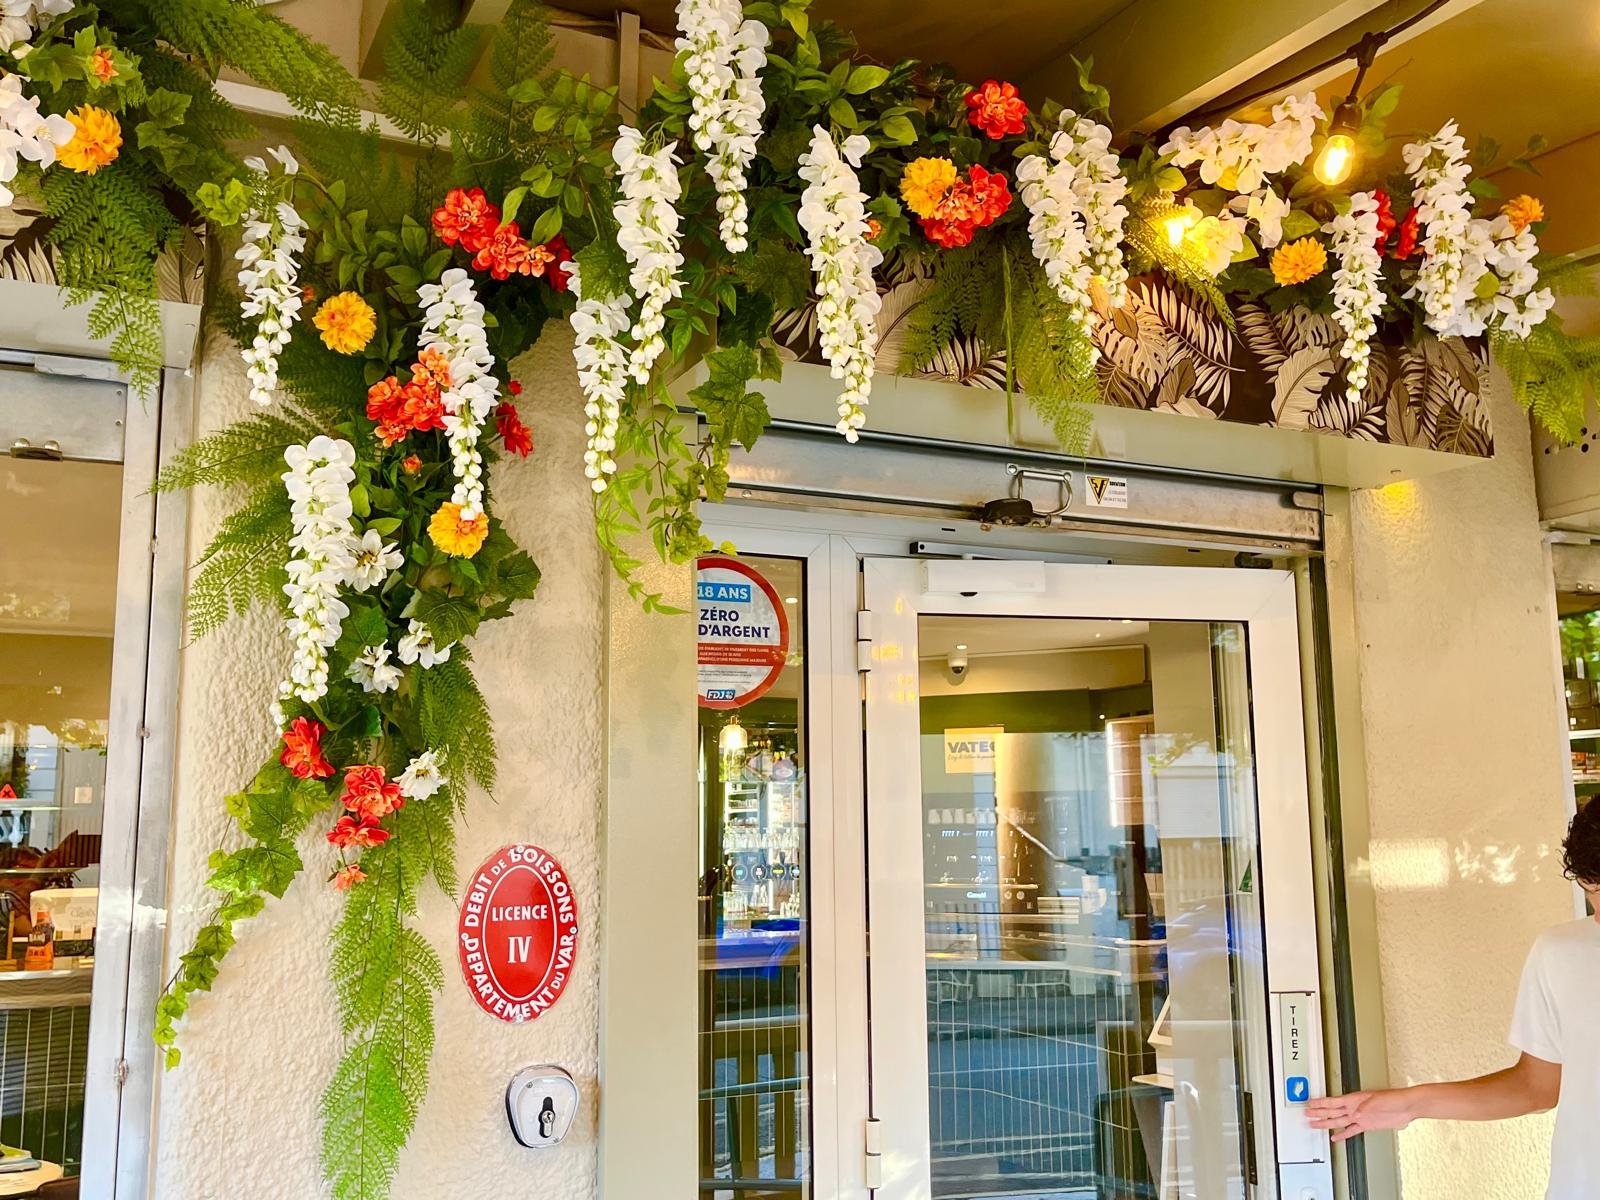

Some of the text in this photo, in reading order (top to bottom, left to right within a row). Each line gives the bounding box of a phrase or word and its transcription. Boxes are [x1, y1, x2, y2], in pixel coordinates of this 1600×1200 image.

[697, 586, 748, 600] 18 ANS
[700, 606, 740, 622] ZÉRO
[698, 624, 770, 638] D'ARGENT
[707, 690, 725, 699] FDJ
[465, 848, 574, 928] DEBIT DE BOISSONS
[492, 904, 548, 922] LICENCE
[507, 936, 533, 963] IV
[465, 934, 574, 1018] DEPARTEMENT DU VAR
[1290, 1005, 1299, 1061] TIREZ
